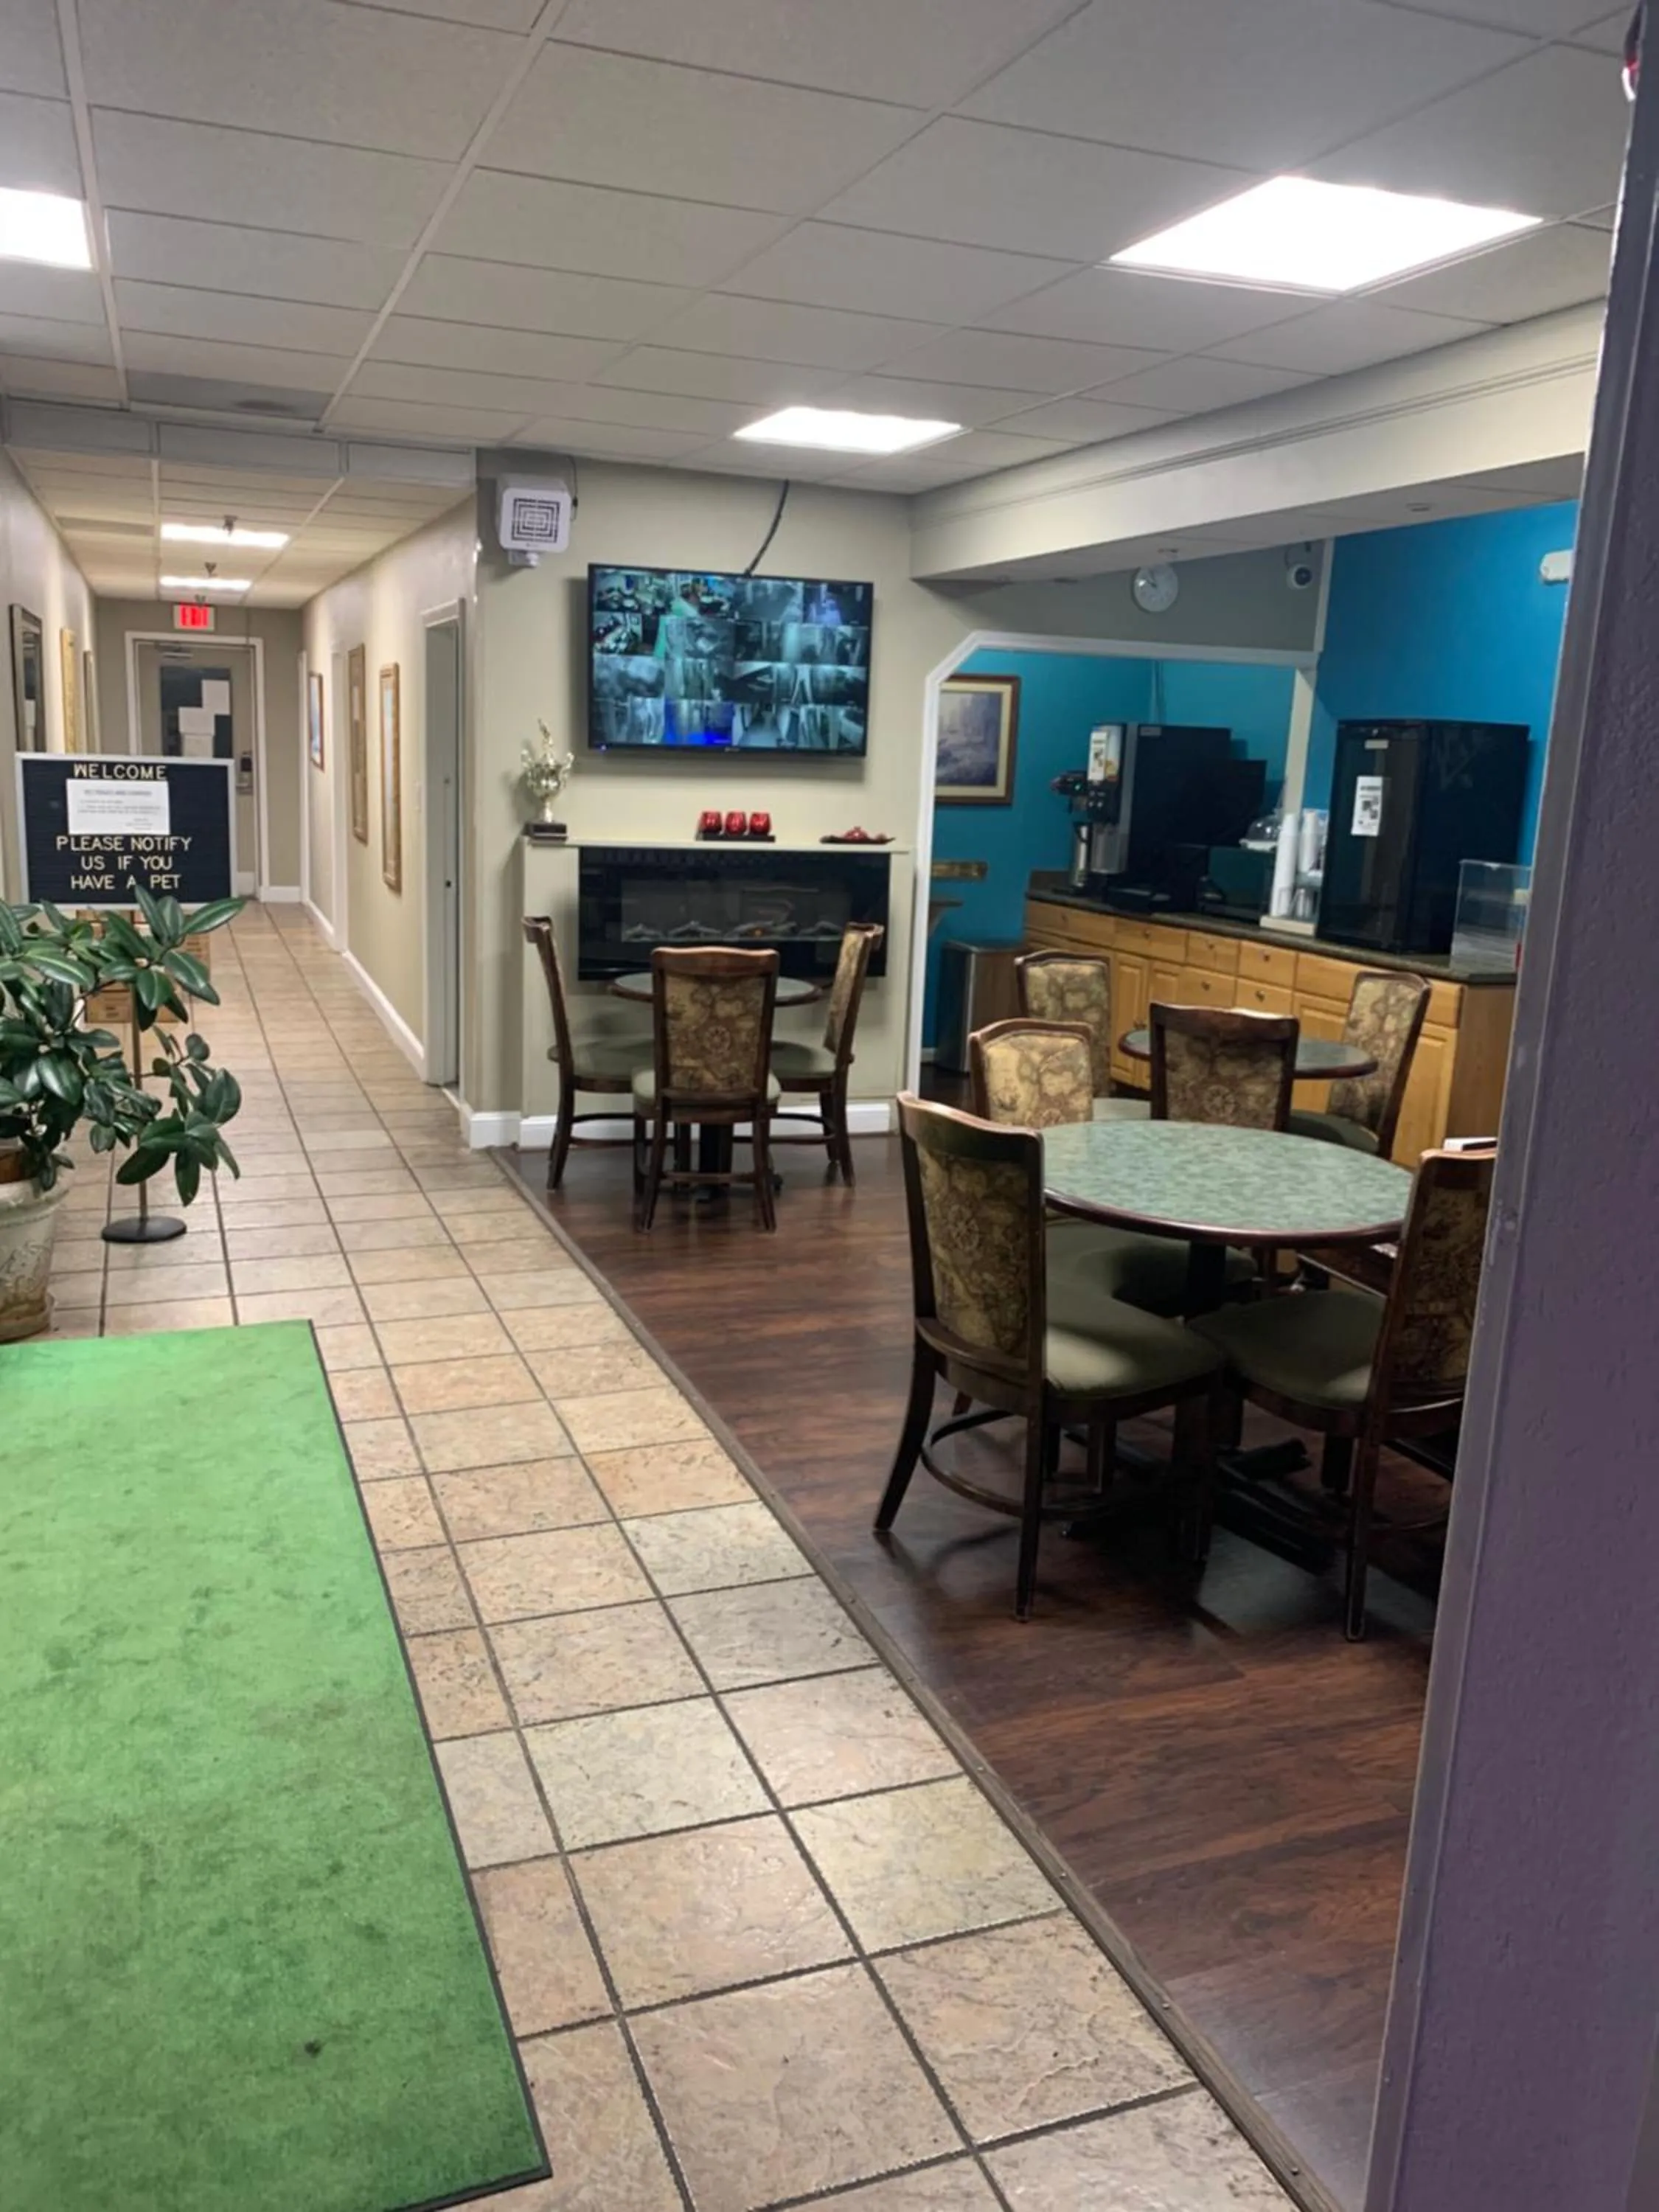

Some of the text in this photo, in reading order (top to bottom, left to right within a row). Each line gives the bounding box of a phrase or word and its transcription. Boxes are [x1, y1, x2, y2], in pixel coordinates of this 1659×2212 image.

[73, 763, 167, 780] WELCOME
[56, 835, 192, 852] PLEASE NOTIFY
[80, 855, 173, 870] US IF YOU
[70, 874, 181, 890] HAVE A PET
